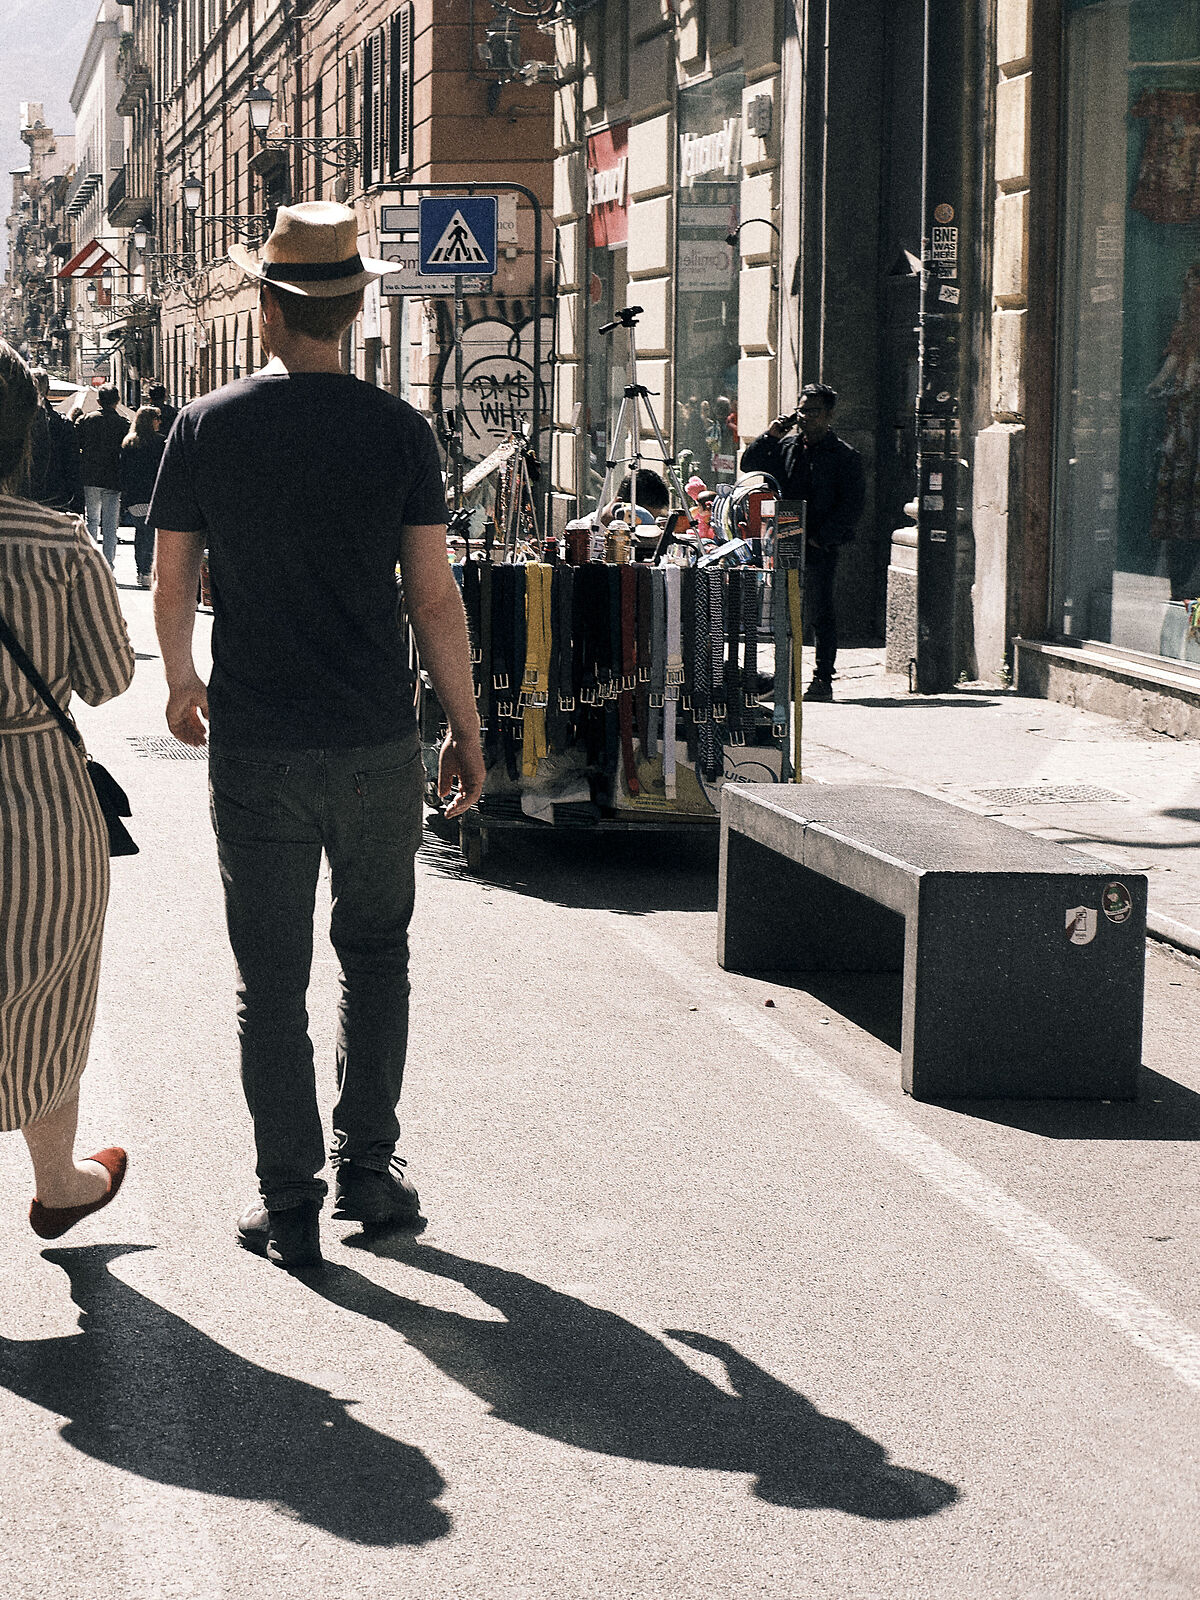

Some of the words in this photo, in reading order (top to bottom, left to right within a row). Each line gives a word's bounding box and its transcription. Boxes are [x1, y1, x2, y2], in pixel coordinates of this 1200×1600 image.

[934, 229, 956, 242] BNE
[934, 243, 955, 251] WAS
[934, 251, 955, 259] HERE
